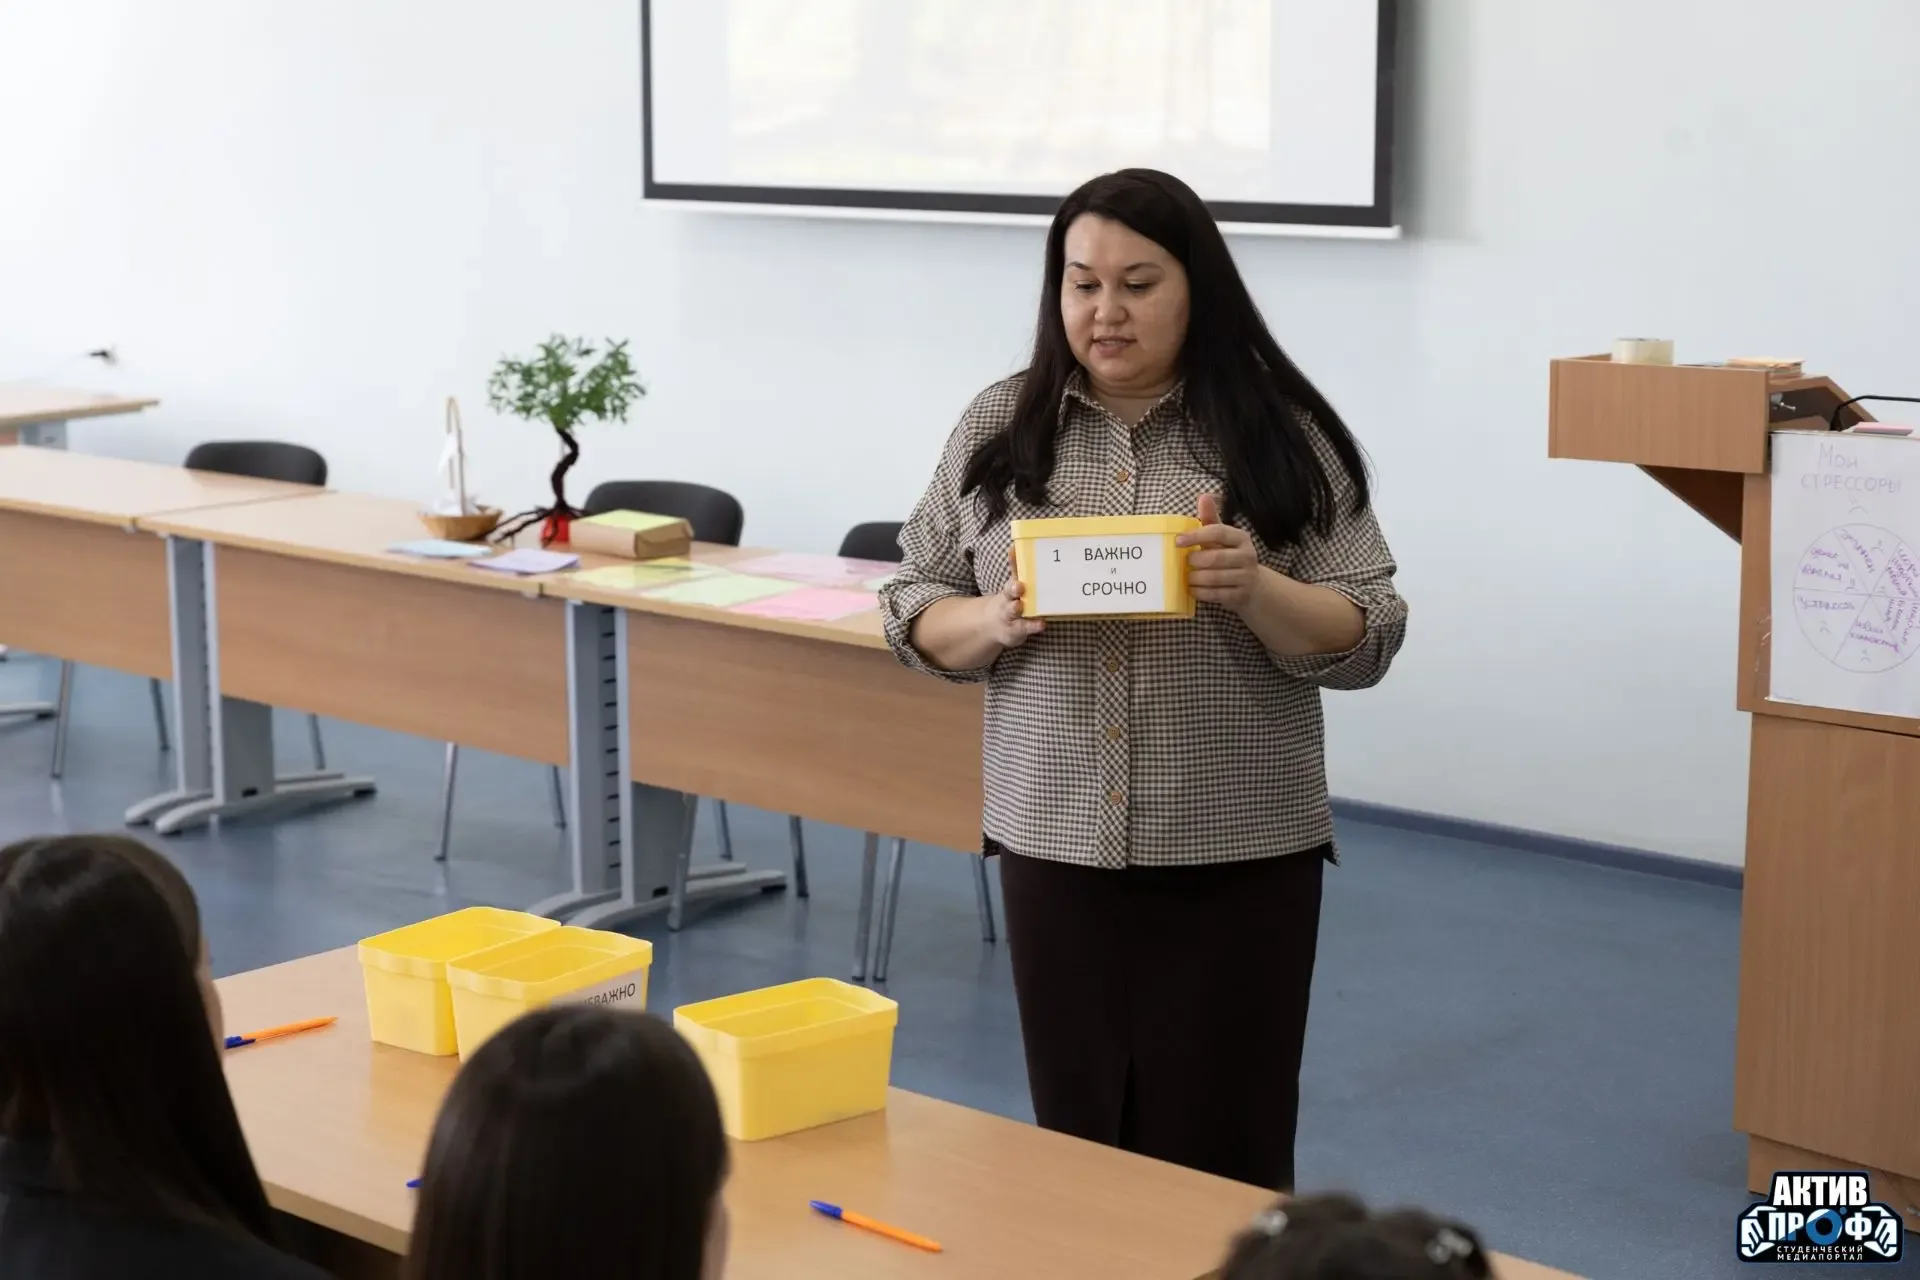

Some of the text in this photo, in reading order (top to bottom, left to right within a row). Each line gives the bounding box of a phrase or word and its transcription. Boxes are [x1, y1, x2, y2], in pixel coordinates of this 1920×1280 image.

[1818, 441, 1858, 469] Мои
[1801, 473, 1902, 494] СТРЕССОРЫ
[1053, 546, 1143, 562] 1 ВАЖНО
[1082, 580, 1147, 596] СРОЧНО
[583, 983, 636, 1006] ЕВАЖНО
